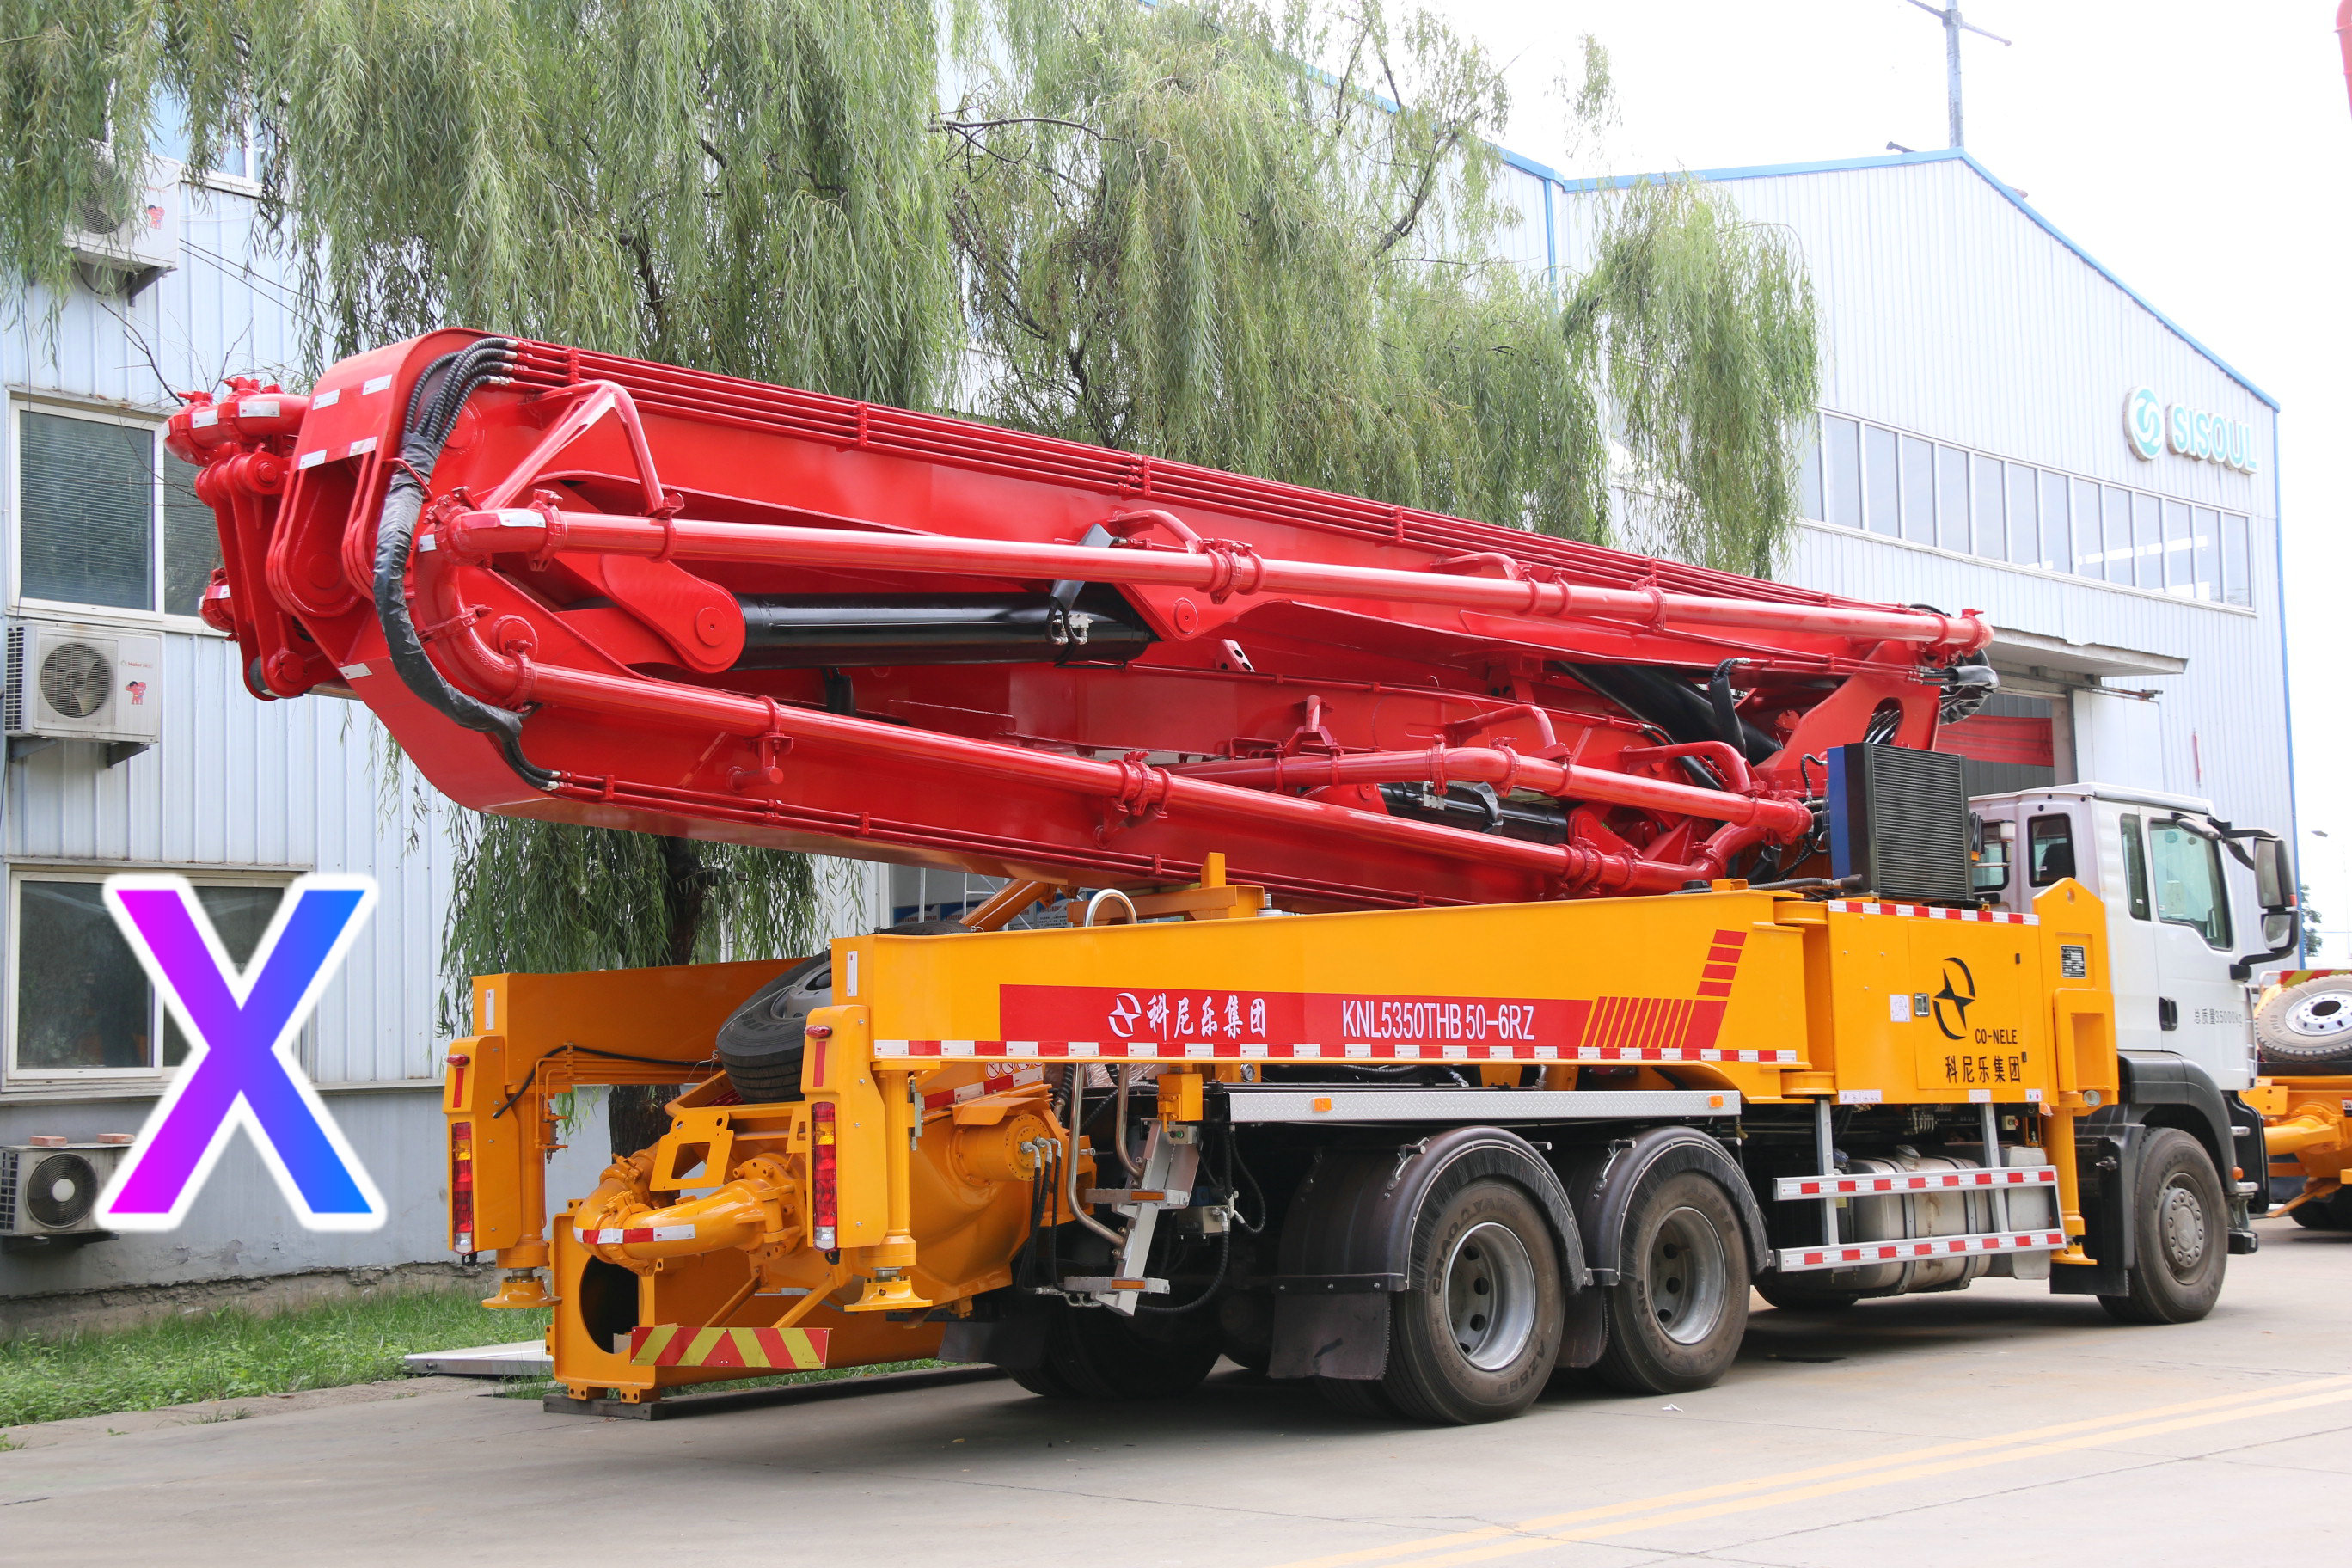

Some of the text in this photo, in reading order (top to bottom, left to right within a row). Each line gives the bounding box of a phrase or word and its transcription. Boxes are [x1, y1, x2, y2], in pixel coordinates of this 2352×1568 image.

[2170, 404, 2257, 471] SISOUL
[1975, 1028, 2018, 1044] CO-NELE
[1945, 1055, 2021, 1083] 科尼乐集团
